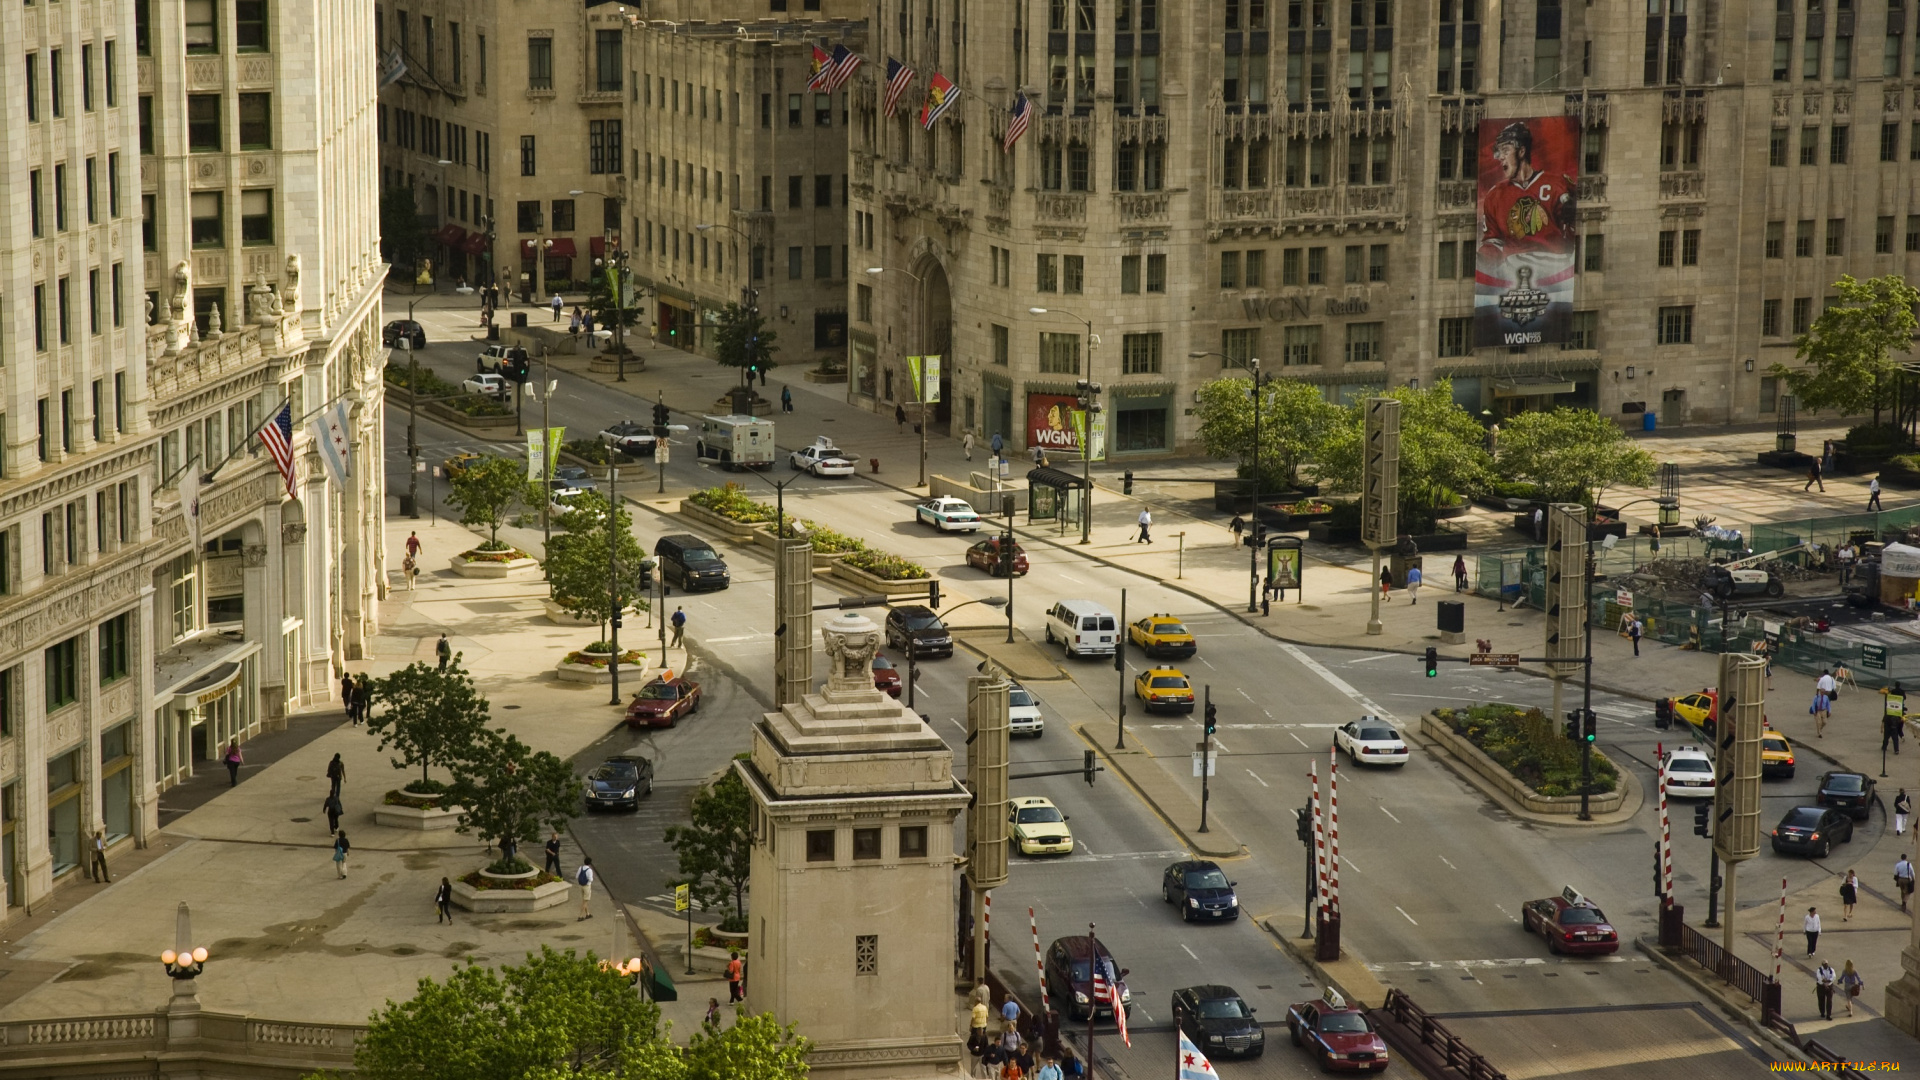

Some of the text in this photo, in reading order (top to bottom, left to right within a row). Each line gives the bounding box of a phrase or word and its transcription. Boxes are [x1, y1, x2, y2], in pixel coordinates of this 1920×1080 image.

[1539, 184, 1552, 201] C
[1500, 294, 1549, 306] FINAL
[1242, 296, 1370, 321] WGN Radio
[1504, 332, 1542, 344] WGN 720
[1035, 429, 1071, 445] WGN
[1740, 555, 1766, 567] TEREX
[819, 764, 859, 775] BEGUN
